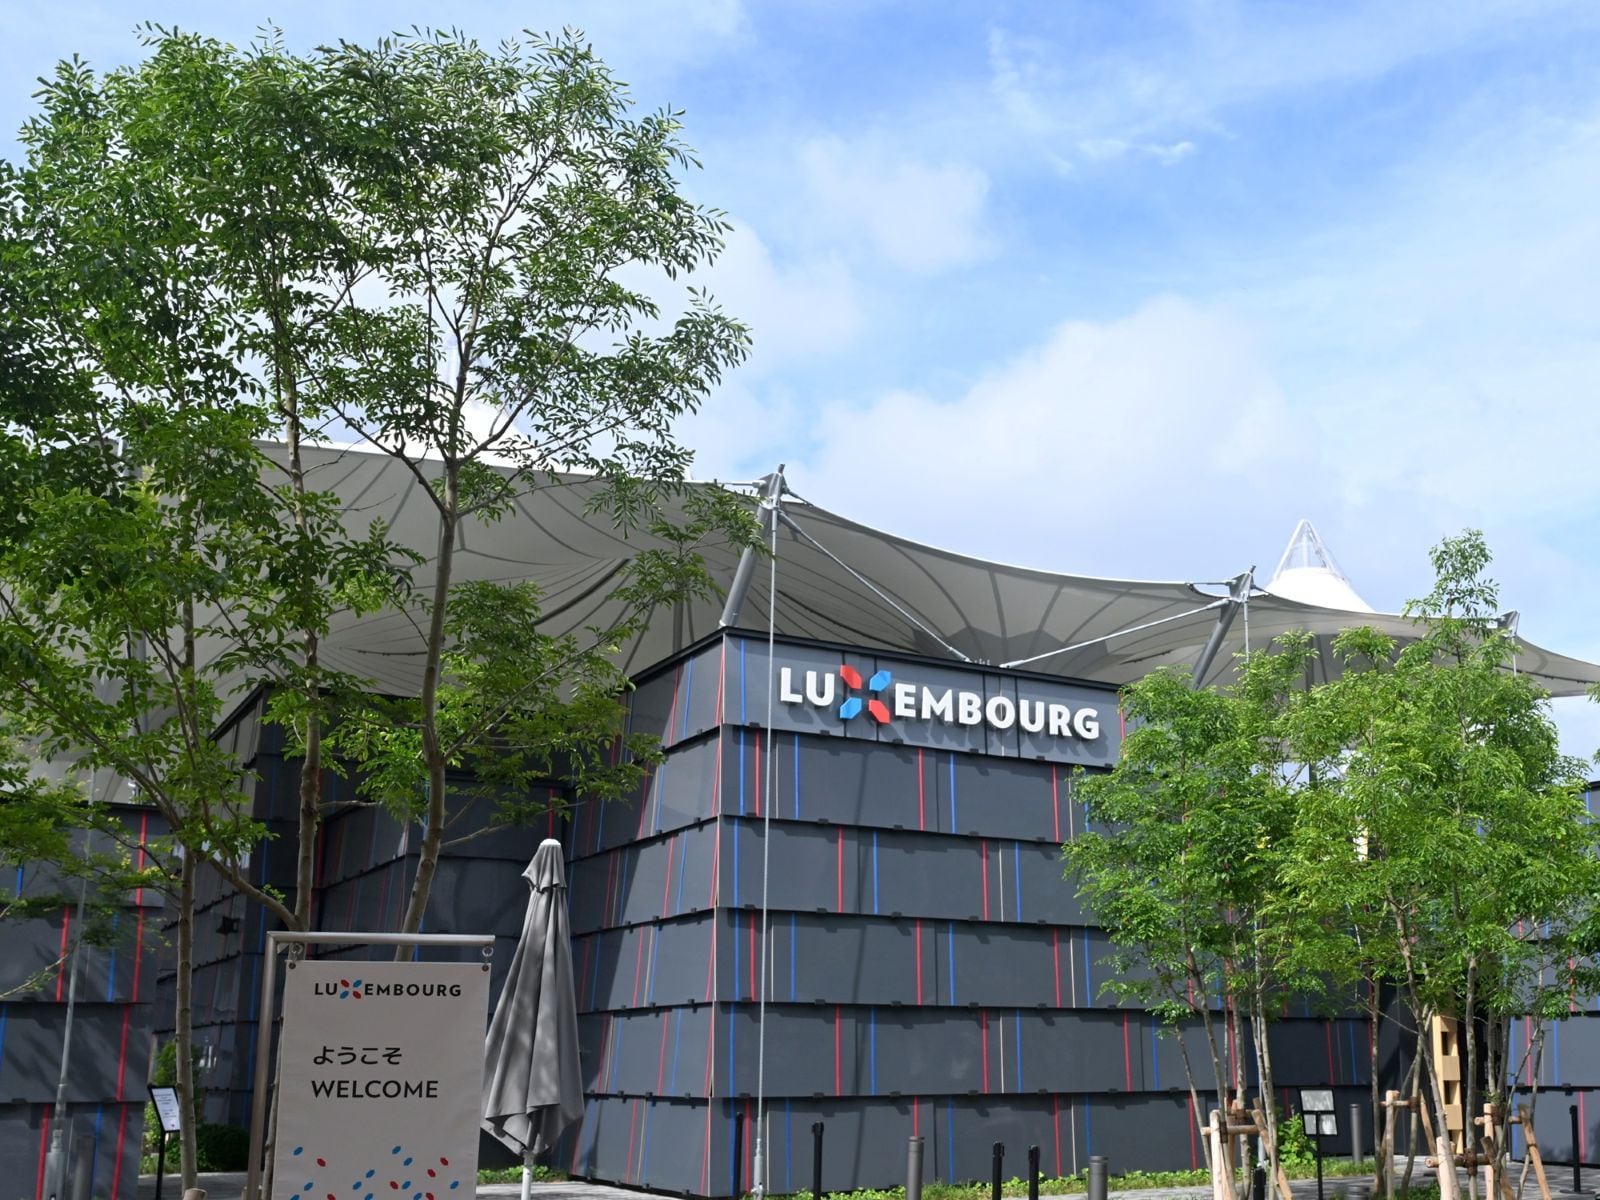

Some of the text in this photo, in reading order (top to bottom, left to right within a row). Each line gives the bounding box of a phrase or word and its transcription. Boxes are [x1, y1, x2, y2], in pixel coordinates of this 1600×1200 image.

[313, 1045, 403, 1066] ようこそ
[311, 1080, 439, 1099] WELCOME
